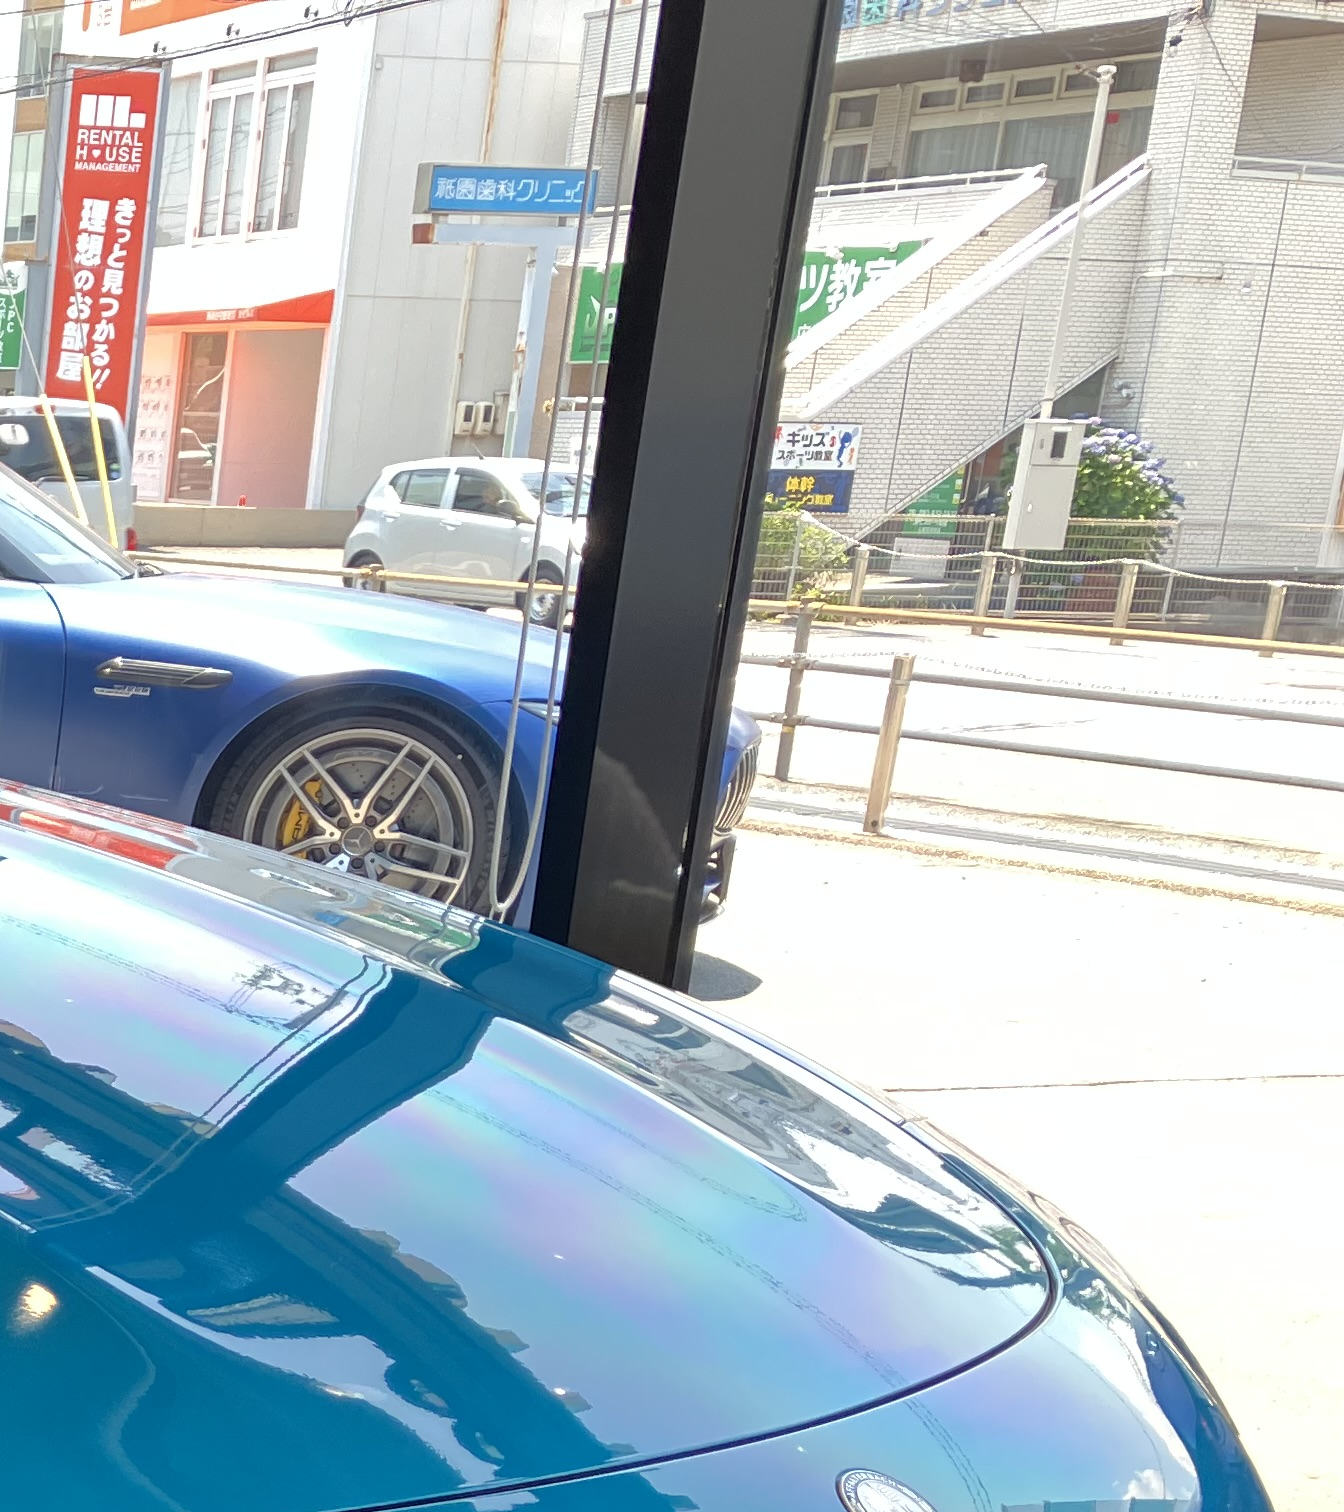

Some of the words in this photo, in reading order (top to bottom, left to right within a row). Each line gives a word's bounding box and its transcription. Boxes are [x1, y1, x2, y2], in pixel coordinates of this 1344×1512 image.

[76, 129, 144, 147] RENTAL
[74, 161, 142, 173] MANAGEMENT
[55, 197, 111, 382] 理想のお部屋
[786, 431, 830, 448] キッズ
[776, 449, 834, 461] スポーツ教室
[785, 475, 815, 492] 体幹
